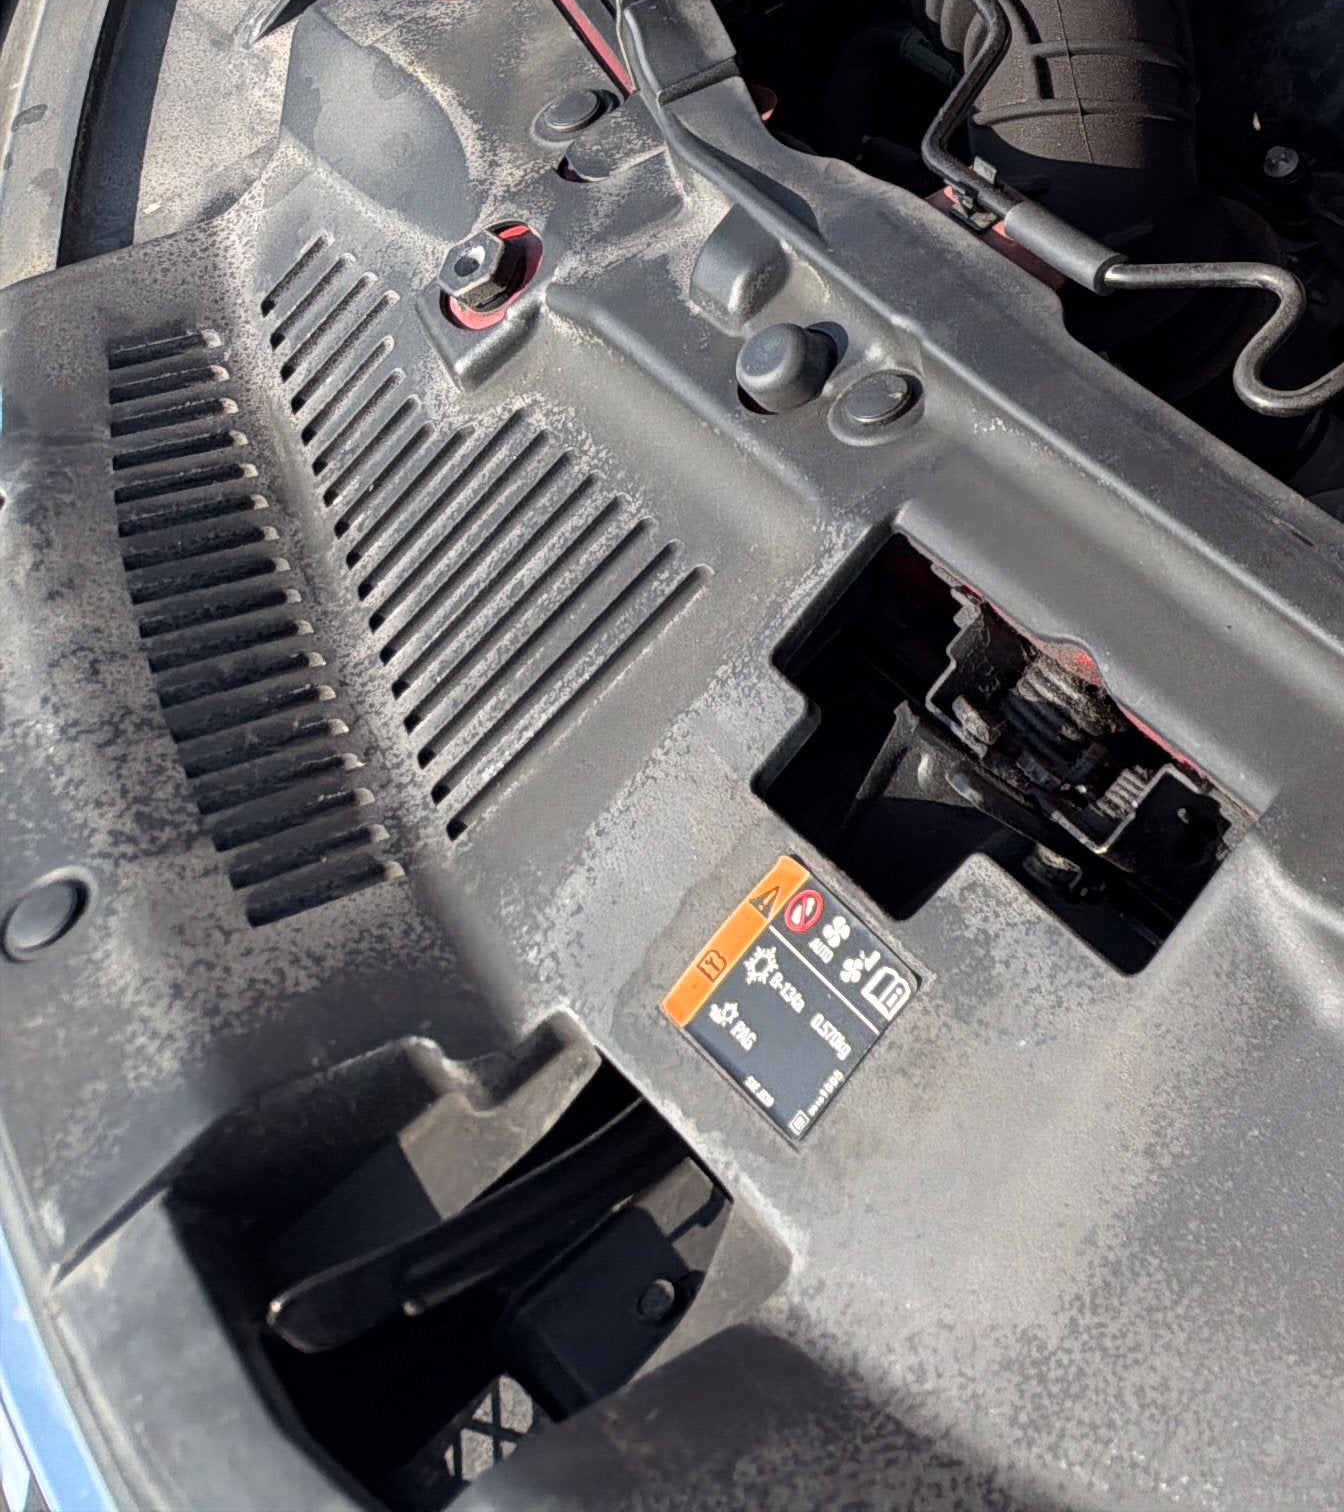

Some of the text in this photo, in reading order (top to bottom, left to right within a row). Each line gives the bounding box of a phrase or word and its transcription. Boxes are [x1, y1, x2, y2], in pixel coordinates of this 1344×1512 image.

[807, 938, 834, 964] AUTO
[768, 971, 805, 1013] R-134a
[730, 1020, 757, 1051] PAG
